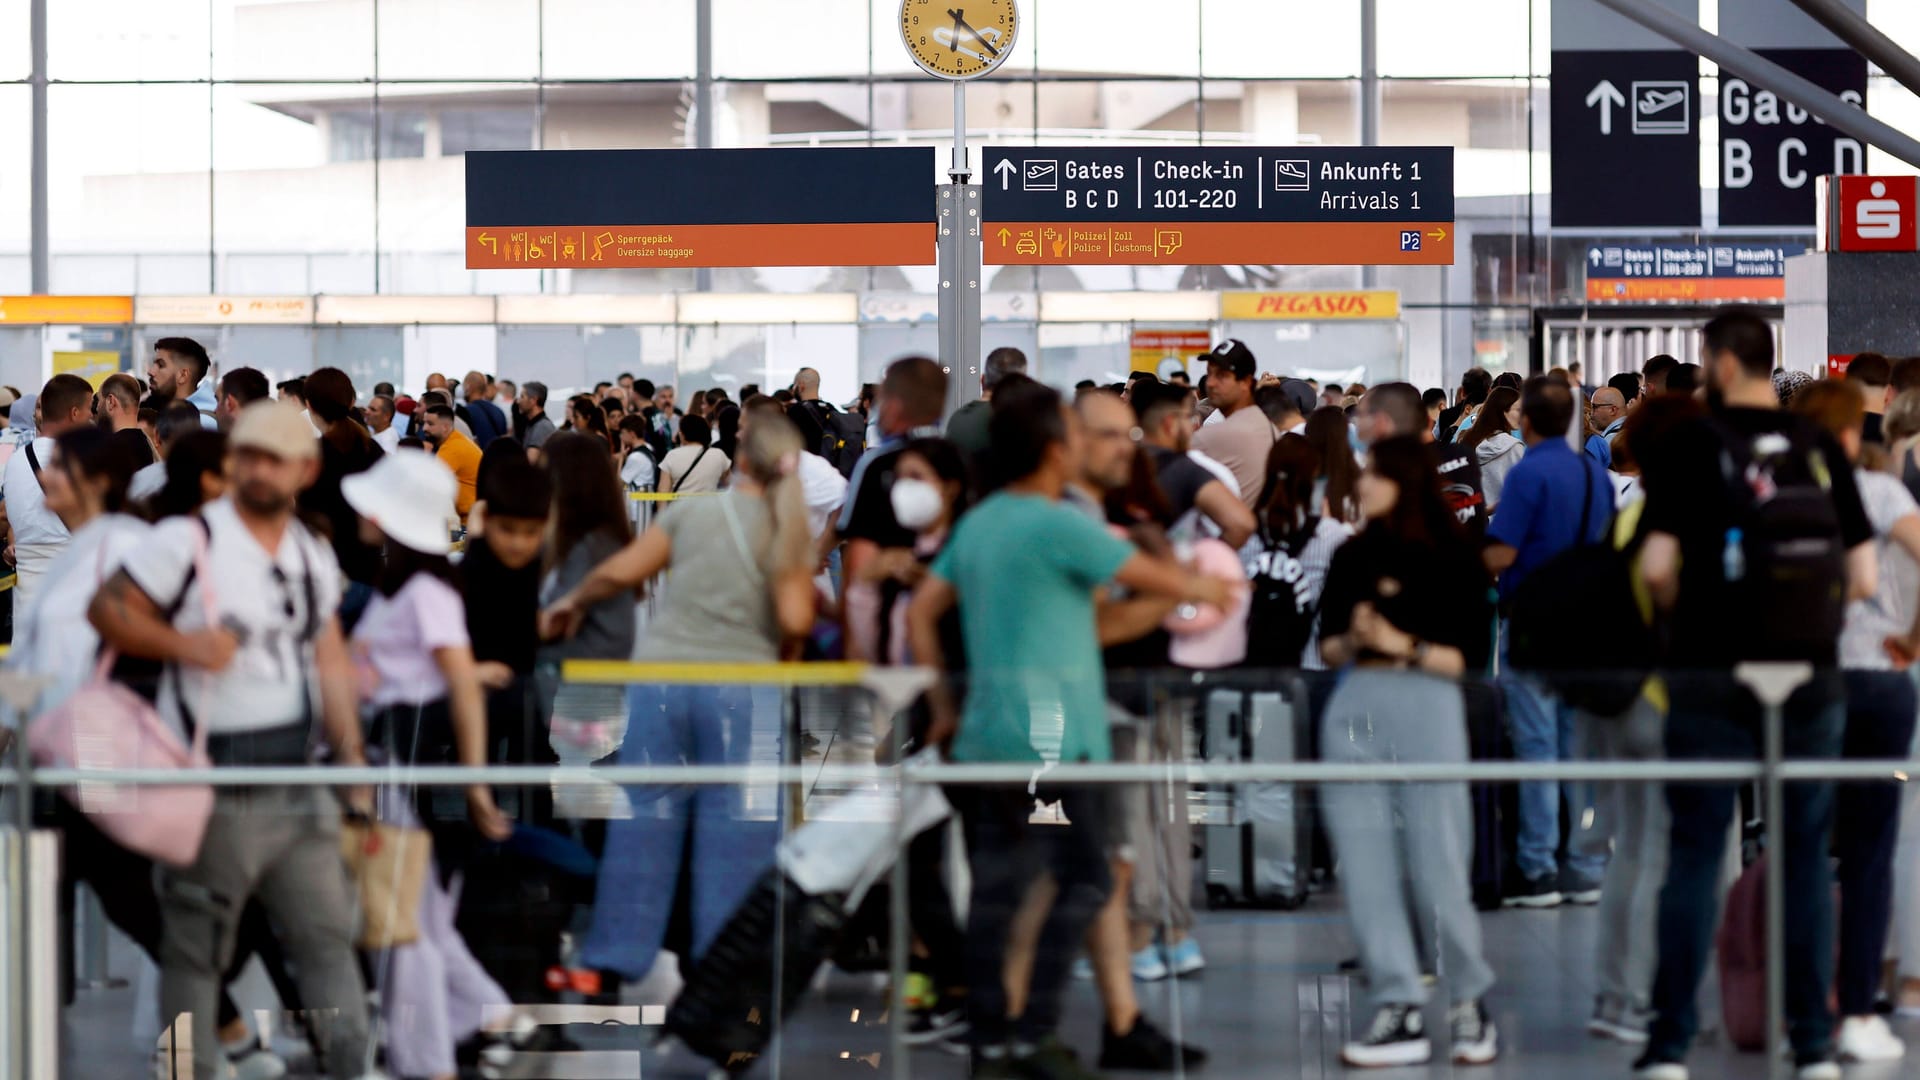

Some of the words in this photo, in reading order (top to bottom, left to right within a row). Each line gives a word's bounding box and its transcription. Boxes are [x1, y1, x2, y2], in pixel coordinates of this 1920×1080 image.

[1065, 160, 1124, 180] Gates
[1154, 160, 1243, 180] Check-in
[1320, 161, 1403, 181] Ankunft
[1410, 161, 1422, 181] 1
[1724, 138, 1754, 188] B
[1778, 137, 1808, 189] C
[1065, 189, 1078, 209] B
[1086, 189, 1098, 209] C
[1107, 189, 1119, 209] D
[1153, 189, 1237, 209] 101-220
[1320, 190, 1399, 210] Arrivals
[1410, 191, 1421, 210] 1
[510, 233, 524, 242] WC
[539, 235, 553, 244] WC
[617, 234, 673, 246] Sperrgepäck
[1073, 231, 1107, 241] Polizei
[1114, 231, 1133, 241] Zoll
[617, 247, 655, 258] Oversize
[657, 247, 694, 259] baggage
[1073, 242, 1102, 253] Police
[1113, 242, 1153, 253] Customs
[1256, 295, 1371, 315] PEGASUS
